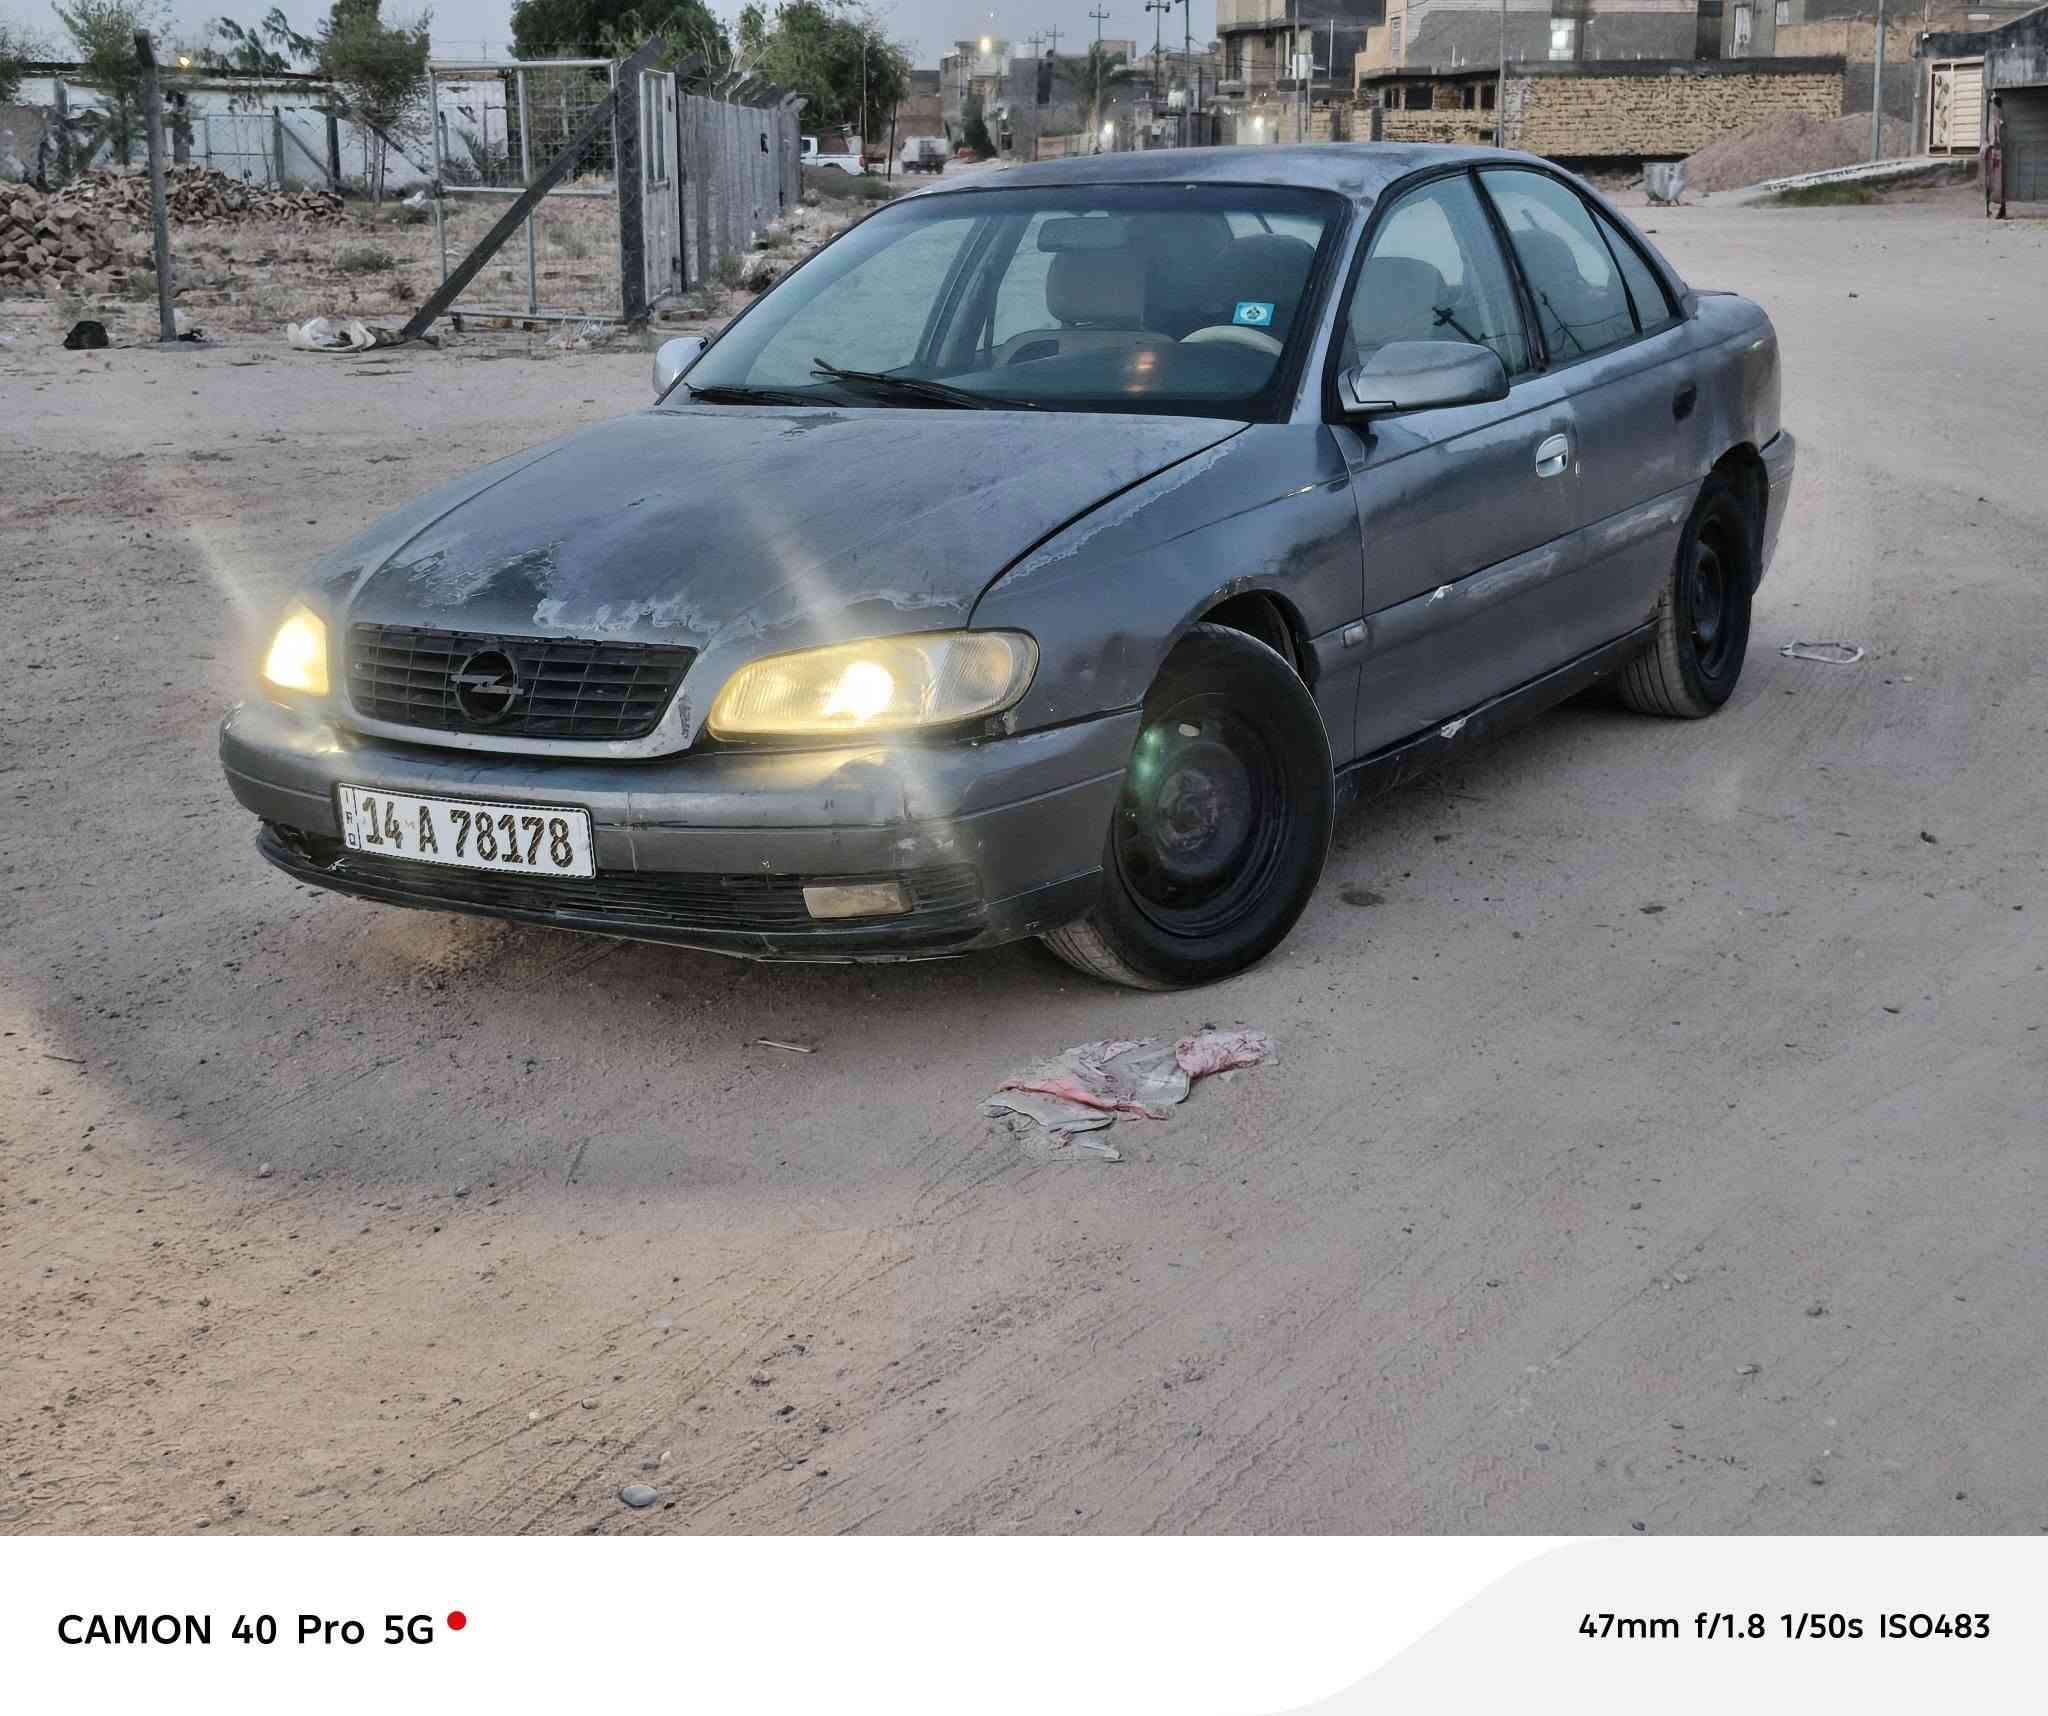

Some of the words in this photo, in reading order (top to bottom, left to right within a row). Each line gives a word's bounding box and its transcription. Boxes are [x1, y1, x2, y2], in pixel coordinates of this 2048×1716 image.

[362, 796, 403, 849] 14
[419, 805, 438, 854] A
[450, 809, 574, 868] 78178
